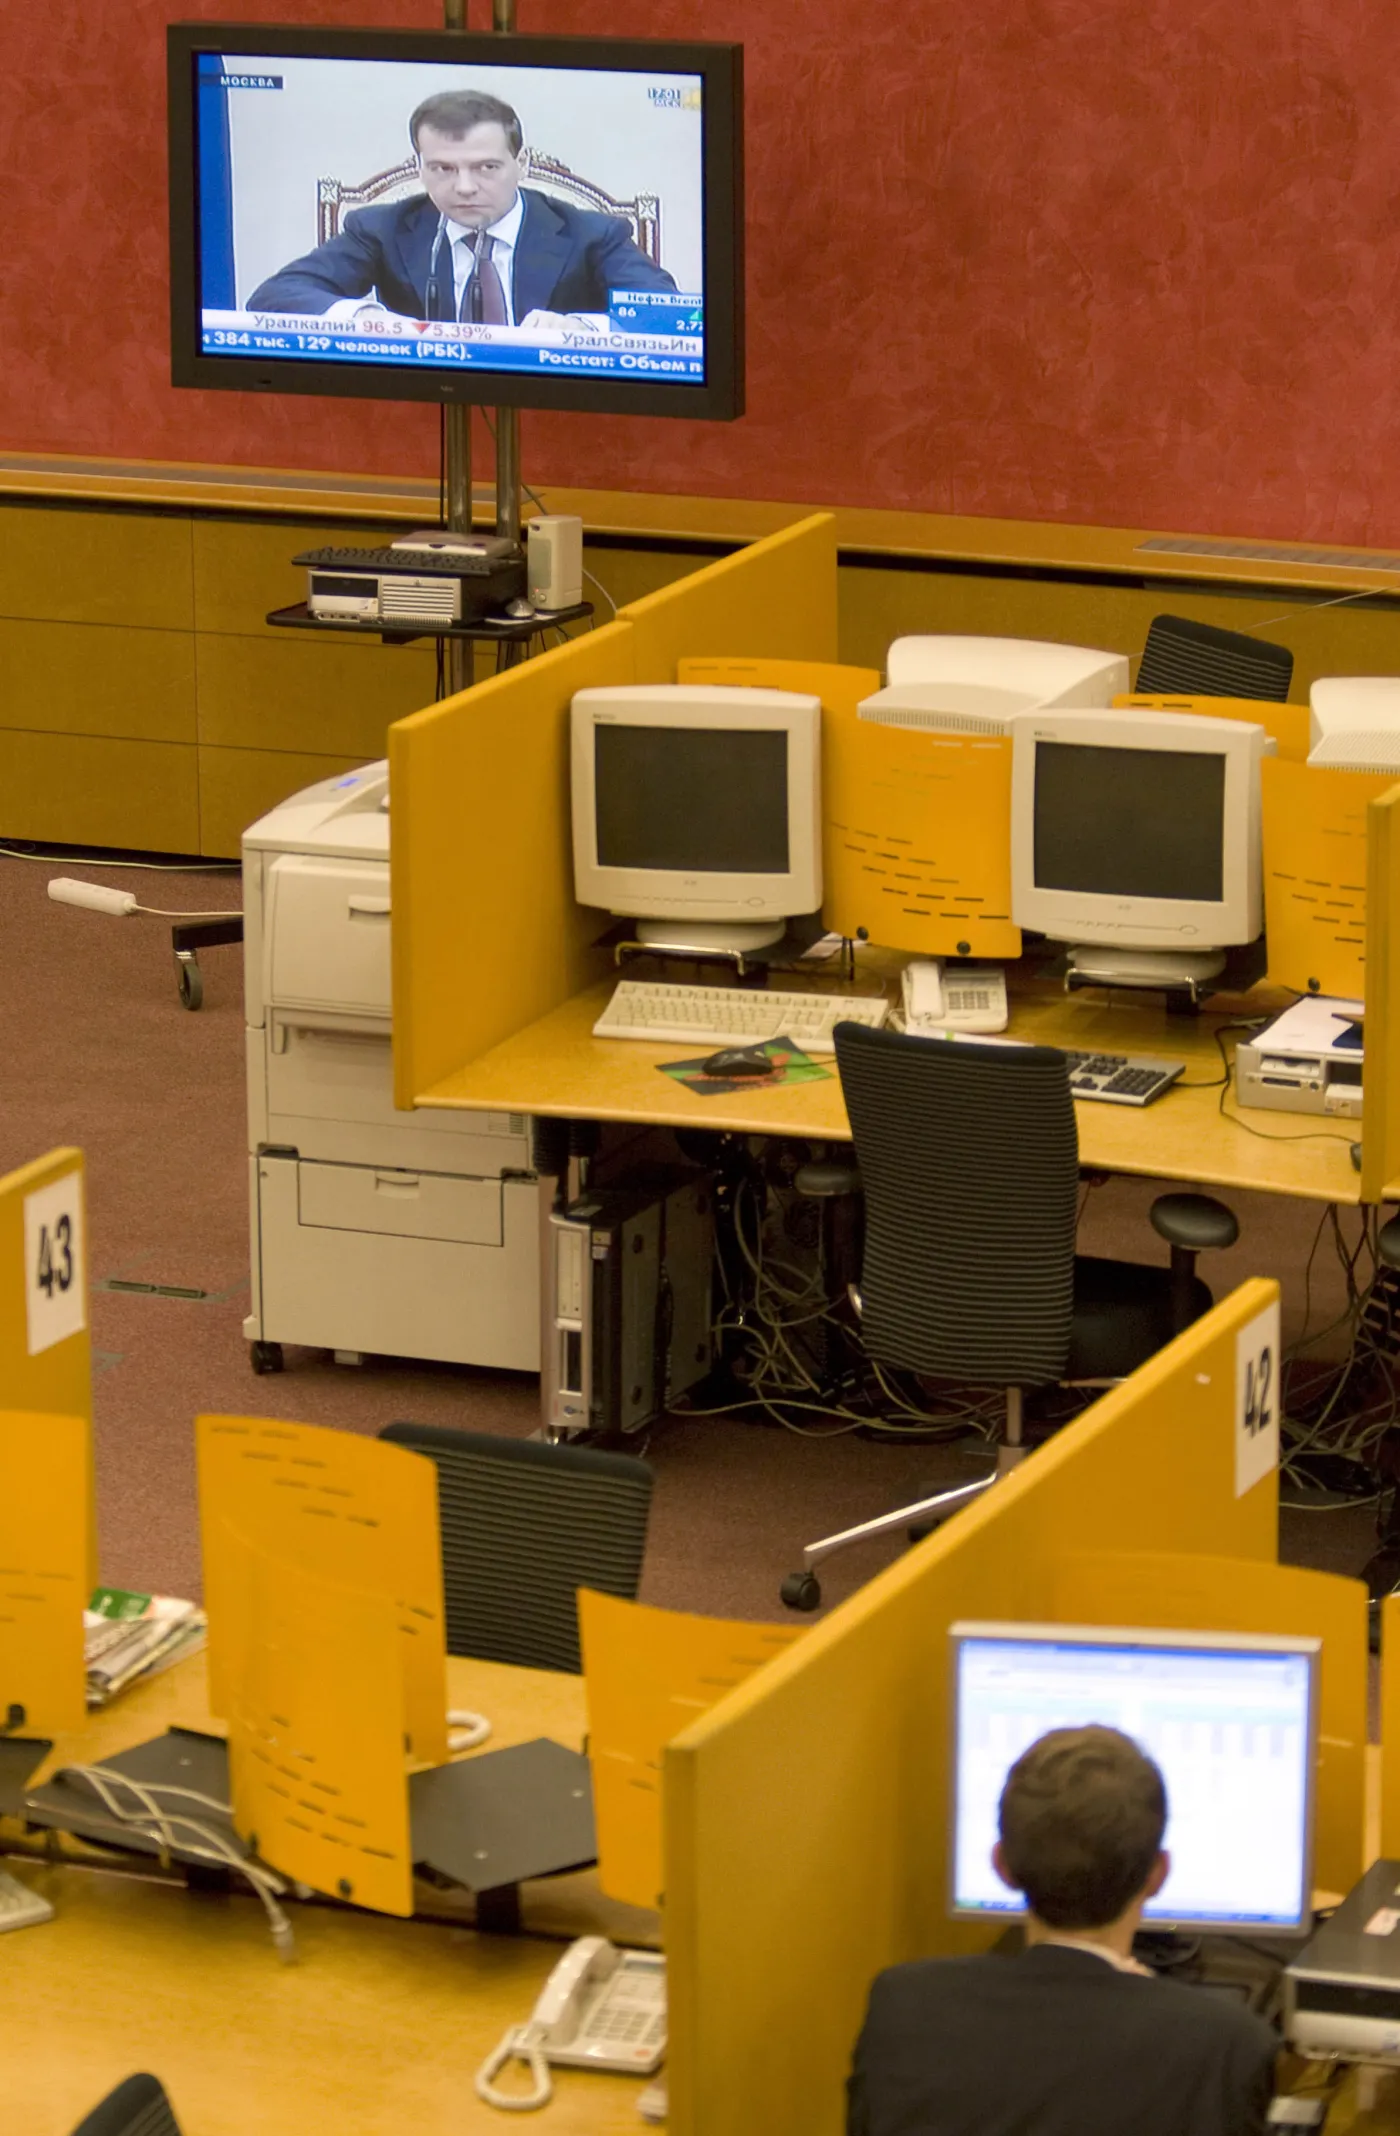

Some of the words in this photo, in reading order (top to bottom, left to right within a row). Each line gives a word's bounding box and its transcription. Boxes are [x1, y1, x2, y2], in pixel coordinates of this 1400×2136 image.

[220, 75, 275, 88] МОСКВА
[618, 306, 637, 317] 86
[254, 314, 356, 332] Уралкалий
[363, 319, 403, 335] 96.5
[432, 323, 492, 340] 5.39%
[213, 330, 250, 346] 384
[254, 335, 291, 349] тыс.
[297, 335, 331, 351] 129
[334, 339, 411, 356] человек
[416, 341, 473, 361] (РБК).
[562, 331, 697, 352] УралСвязьИн
[539, 349, 615, 367] Росстат:
[619, 354, 686, 373] Объем
[37, 1214, 73, 1299] 43
[1244, 1345, 1271, 1438] 42
